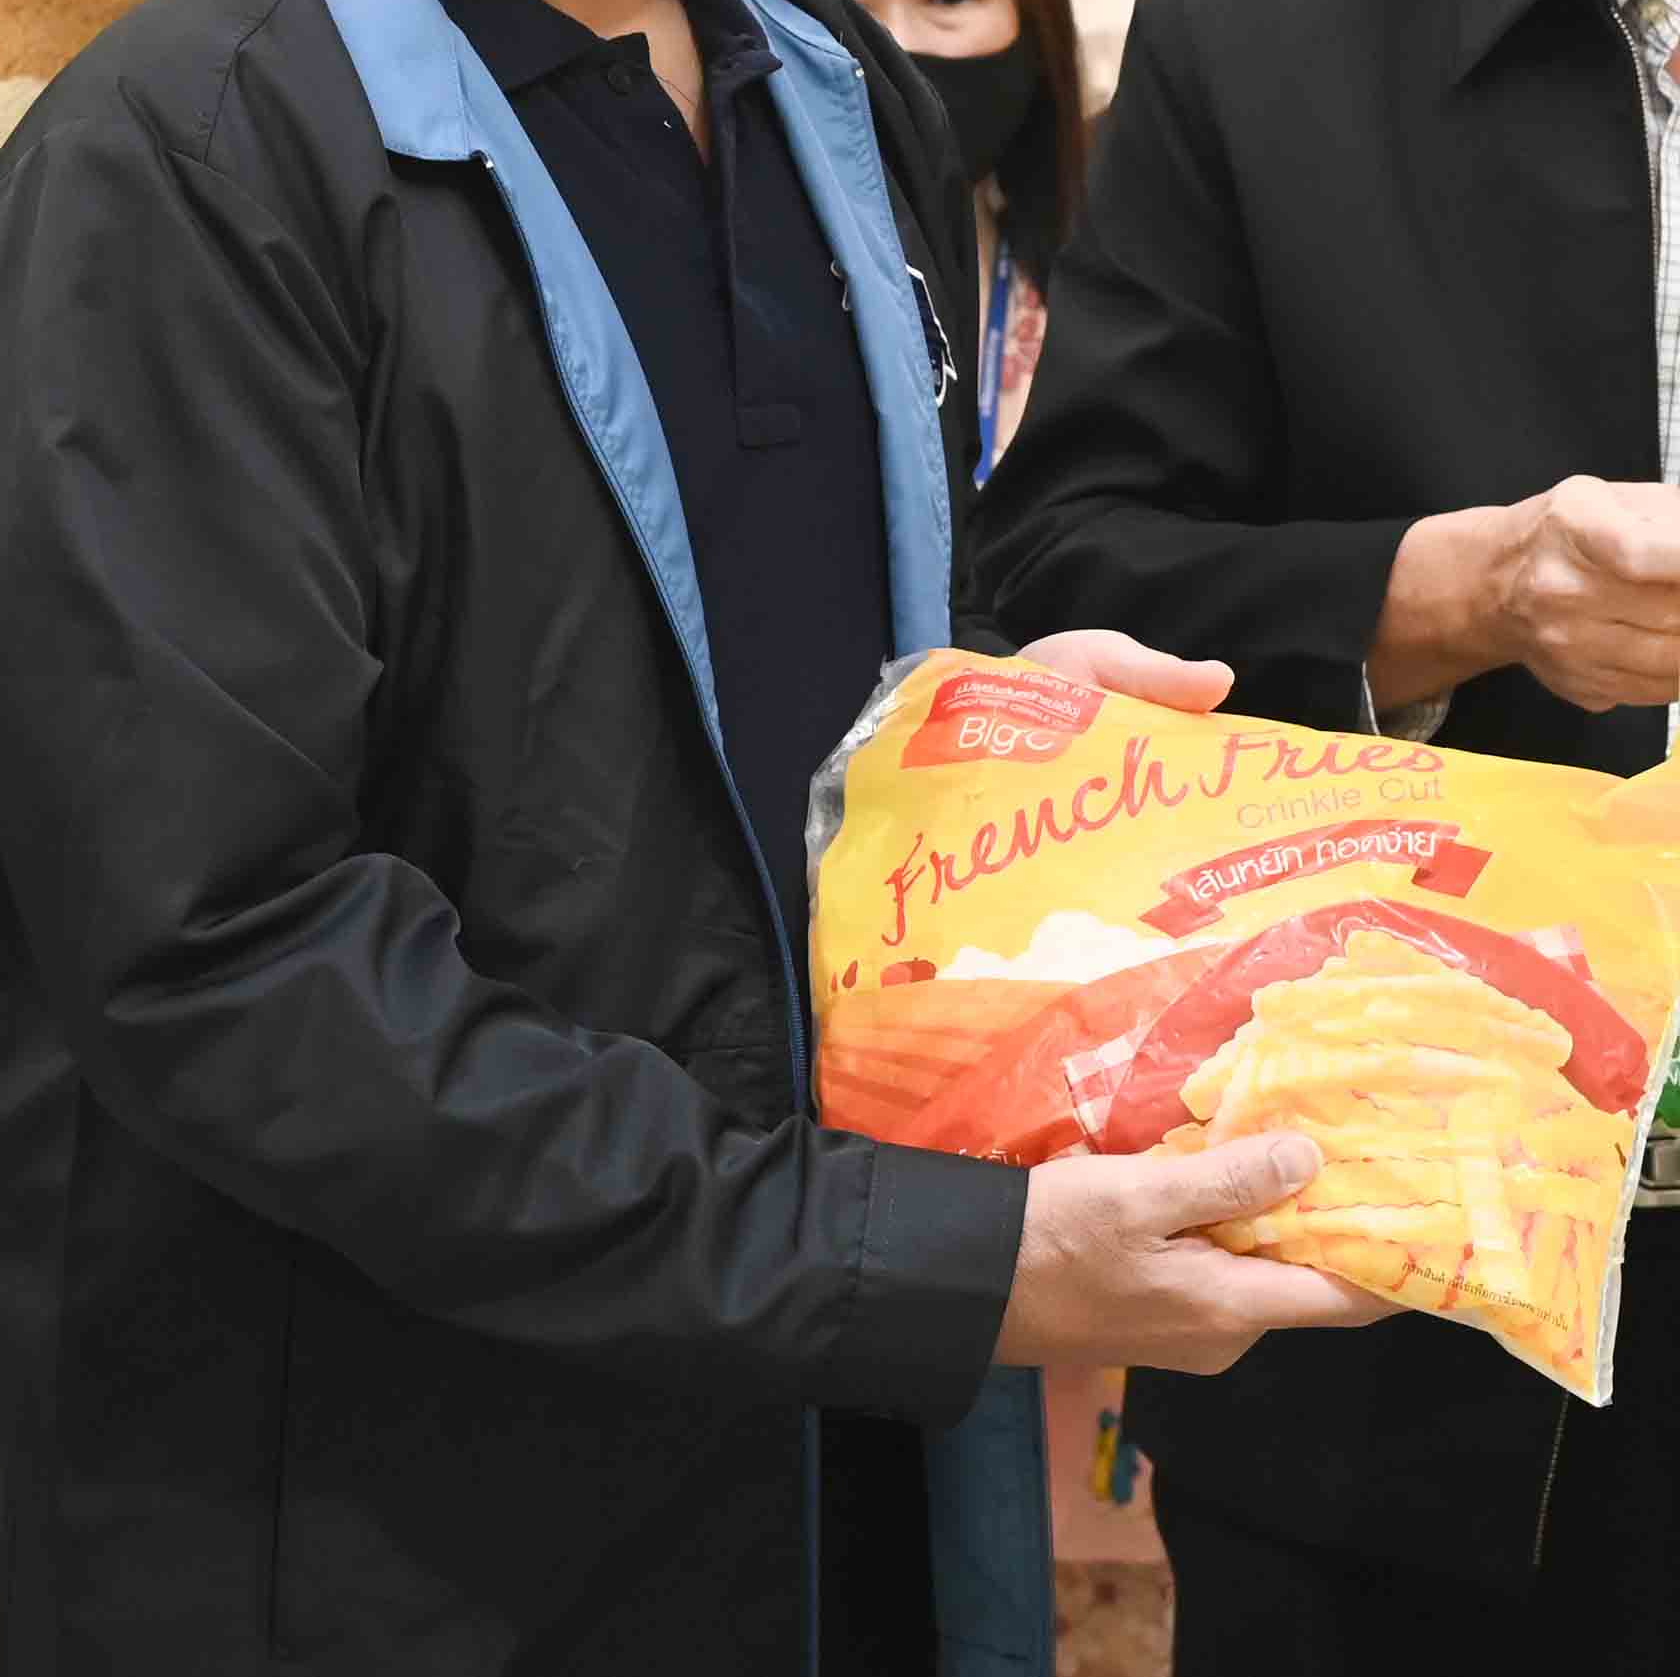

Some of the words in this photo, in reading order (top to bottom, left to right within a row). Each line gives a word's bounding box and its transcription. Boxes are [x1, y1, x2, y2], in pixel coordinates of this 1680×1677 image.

[957, 710, 1022, 757] Big
[1235, 785, 1363, 830] Crinkle
[1377, 775, 1446, 804] Cut
[880, 733, 1191, 948] French
[1198, 728, 1446, 800] Fries
[1185, 845, 1305, 902] เส้นหยัก
[1314, 826, 1438, 867] ทอดง่าย
